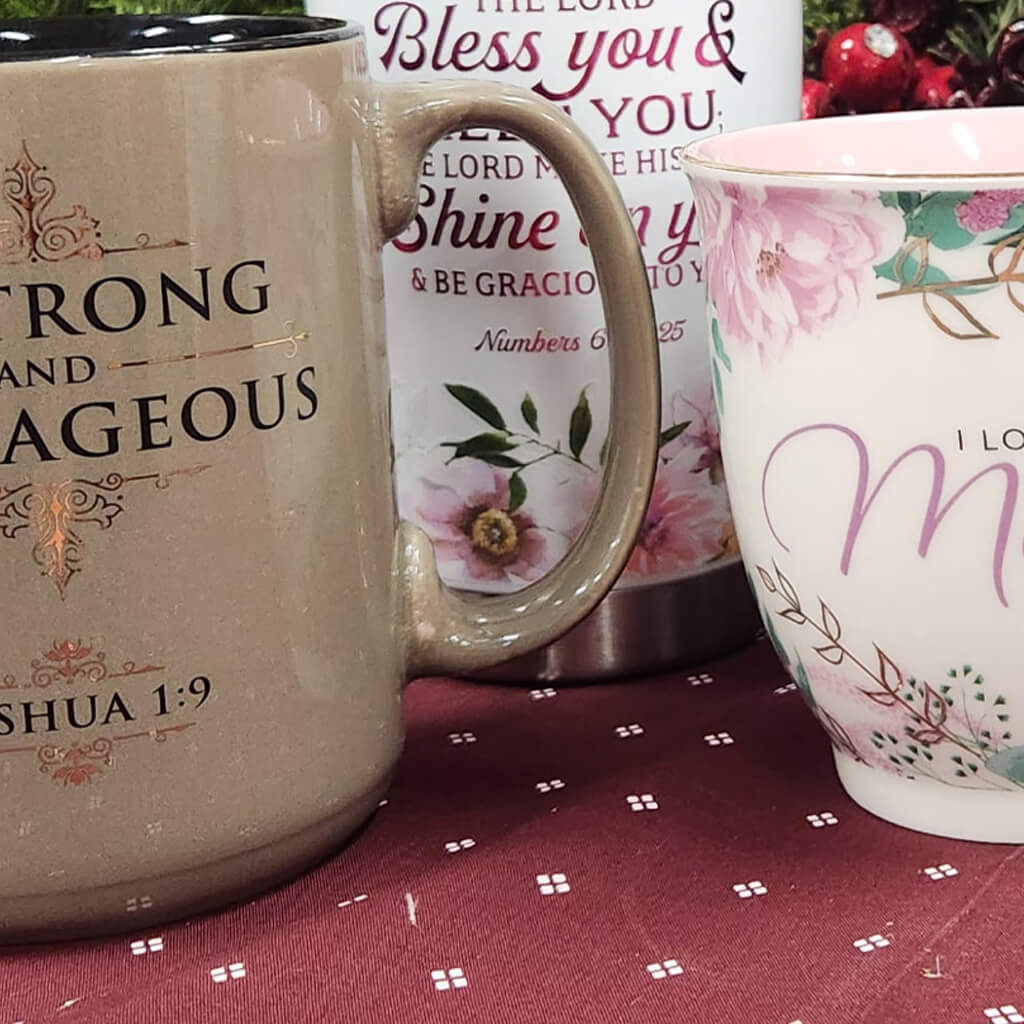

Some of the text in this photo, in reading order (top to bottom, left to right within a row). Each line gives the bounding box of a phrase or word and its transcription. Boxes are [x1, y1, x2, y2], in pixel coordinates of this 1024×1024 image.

[374, 1, 542, 73] Bless
[531, 25, 684, 101] you
[443, 153, 524, 180] LORD
[411, 268, 427, 292] &
[435, 270, 468, 295] BE
[475, 270, 597, 298] GRACIO
[474, 328, 580, 353] Numbers
[0, 355, 96, 391] AND
[957, 429, 965, 452] I
[152, 675, 212, 717] 1:9
